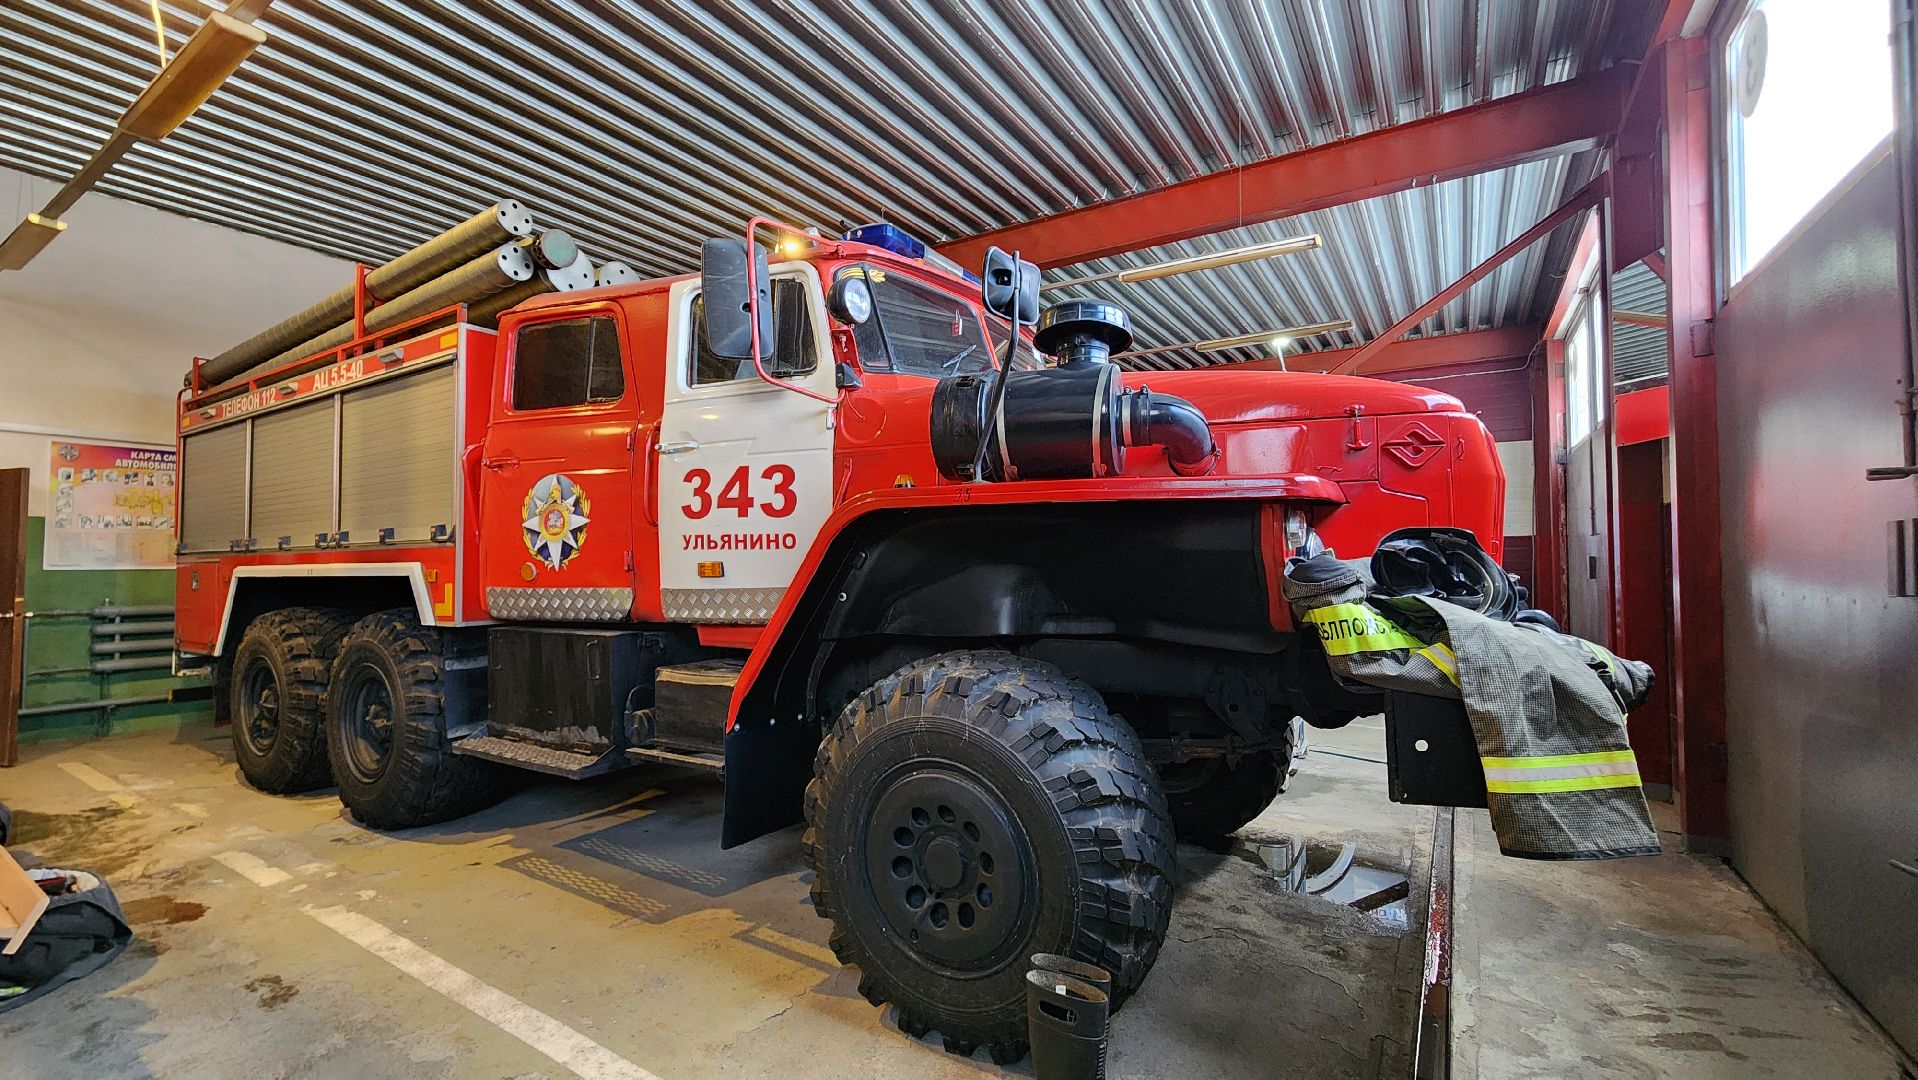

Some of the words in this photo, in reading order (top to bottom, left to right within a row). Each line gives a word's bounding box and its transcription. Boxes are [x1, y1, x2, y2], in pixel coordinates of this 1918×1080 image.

[312, 371, 329, 392] АЦ
[331, 359, 364, 385] 5.5-40
[222, 394, 260, 418] ТЕЛЕФОН
[262, 387, 277, 407] 112
[130, 451, 162, 462] КАРТА
[163, 454, 176, 463] СМ
[681, 464, 798, 520] 343
[682, 532, 797, 551] УЛЬЯНИНО
